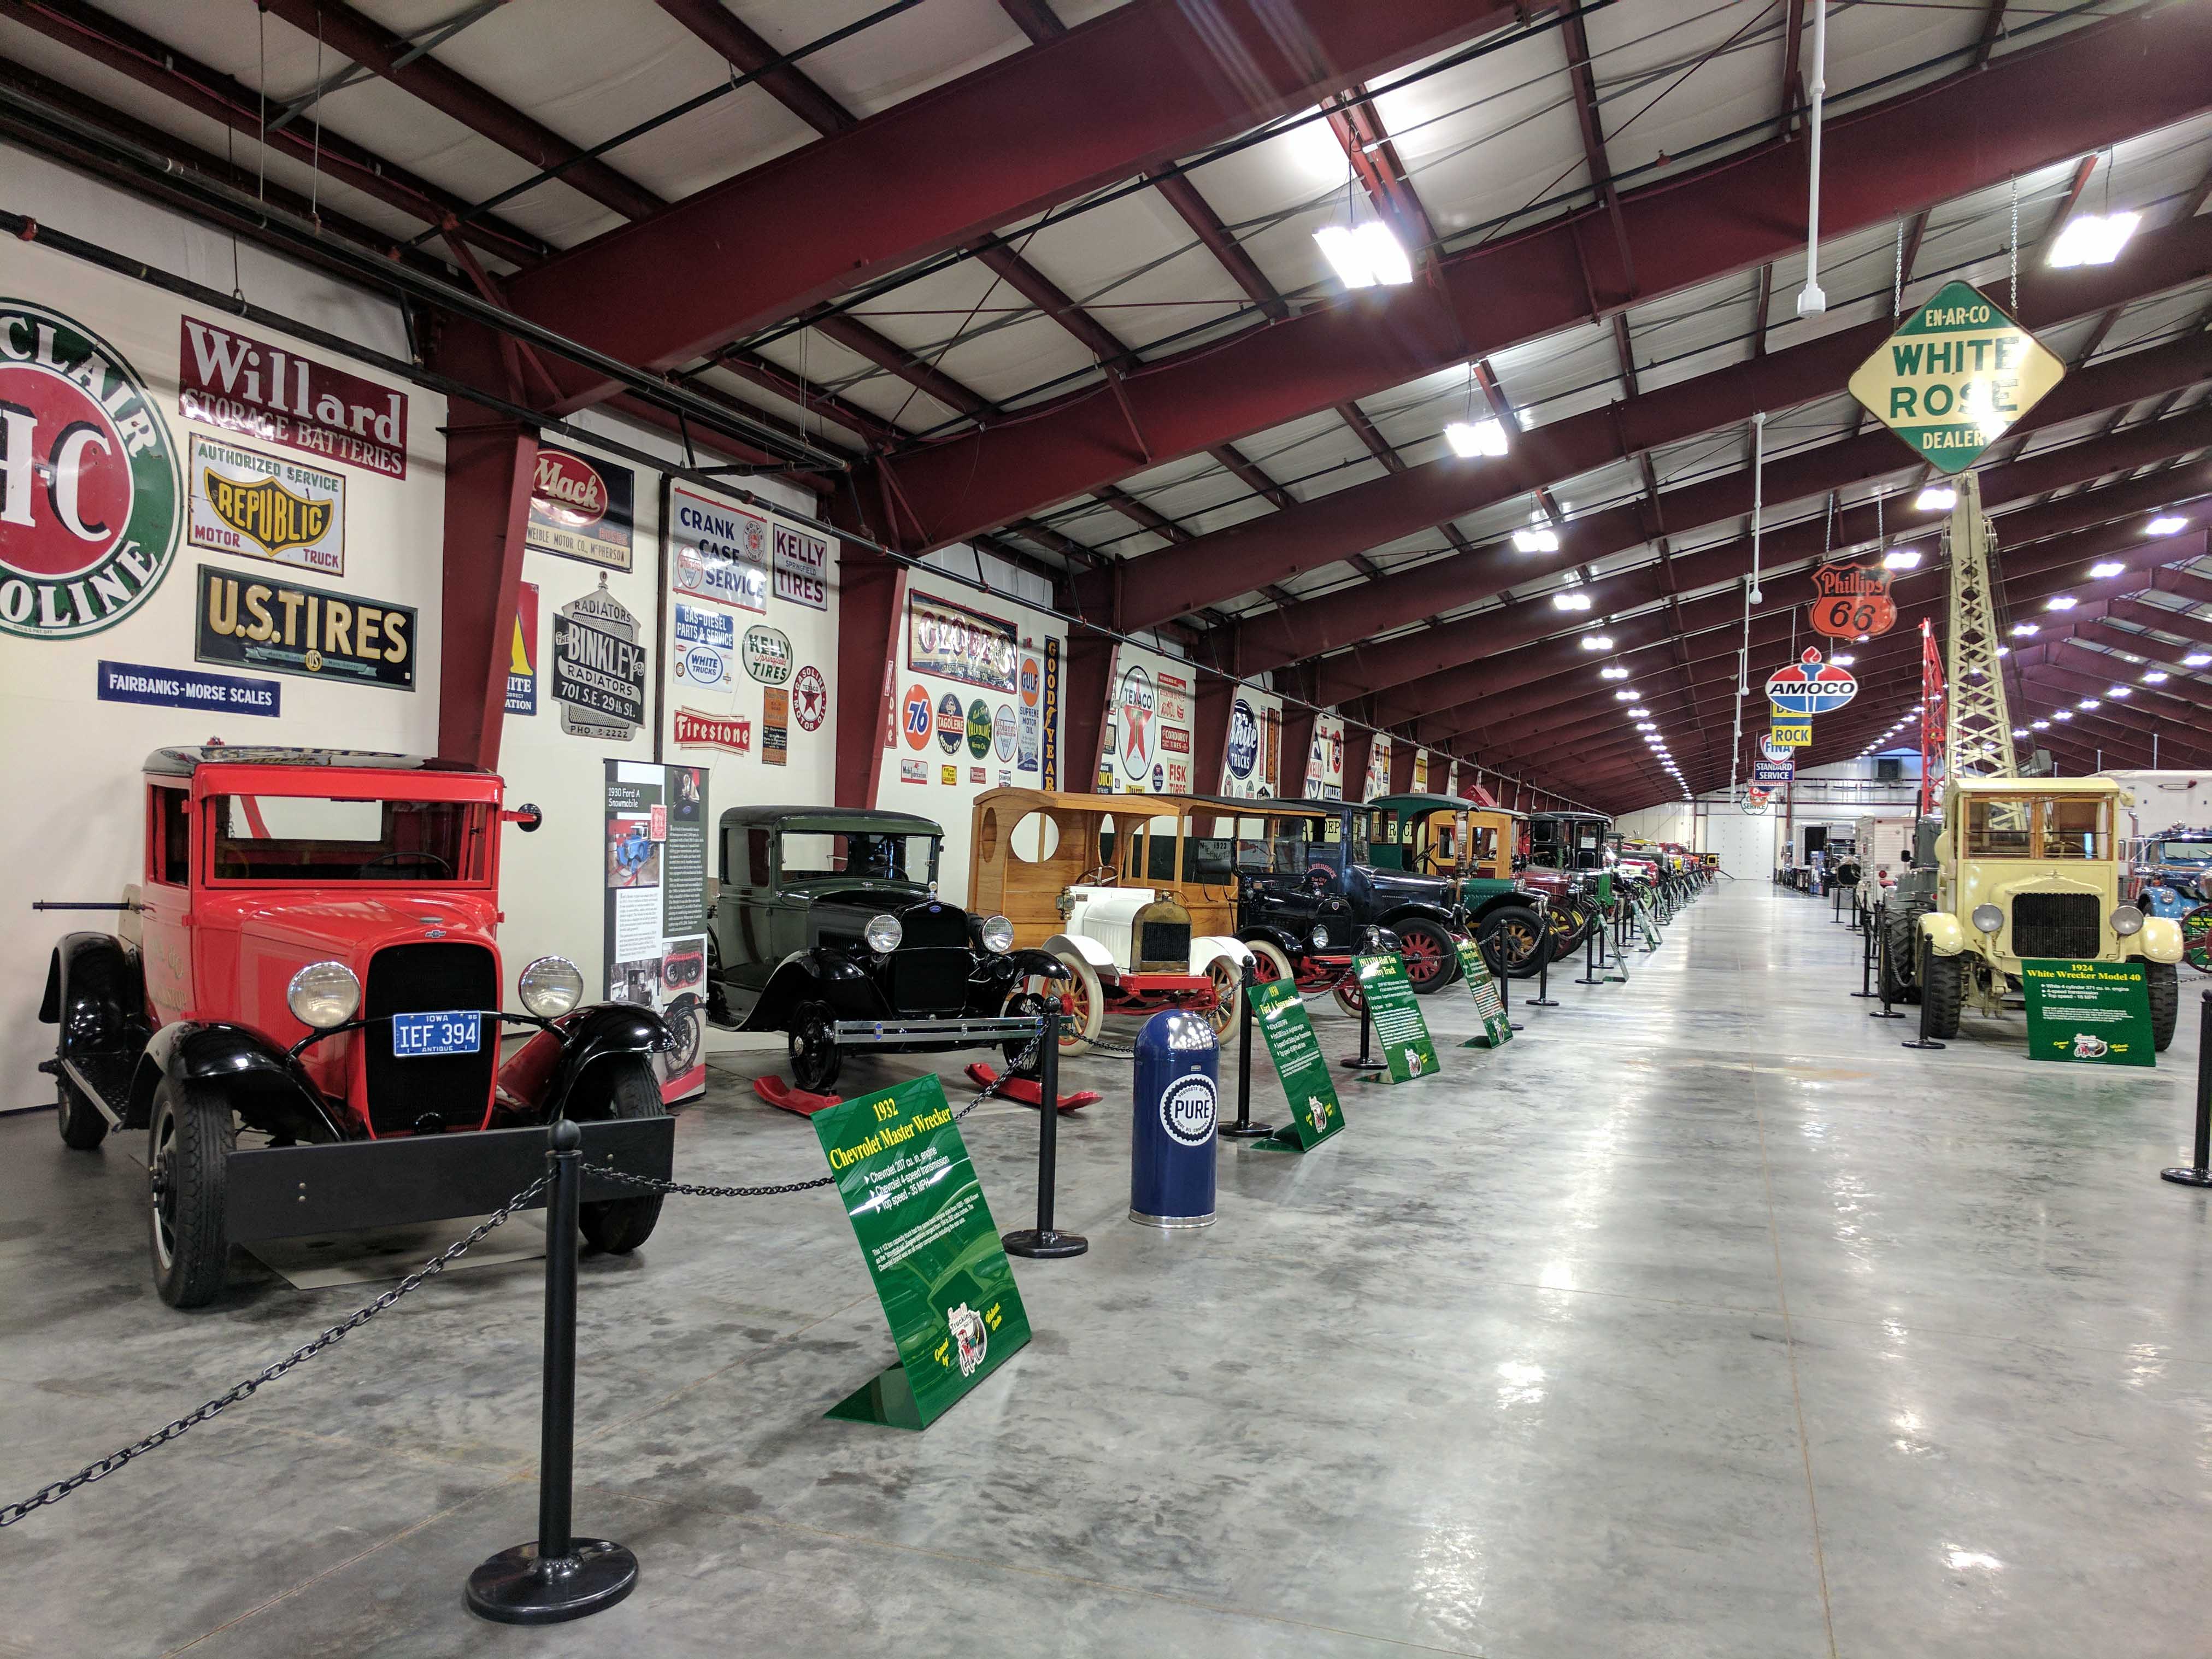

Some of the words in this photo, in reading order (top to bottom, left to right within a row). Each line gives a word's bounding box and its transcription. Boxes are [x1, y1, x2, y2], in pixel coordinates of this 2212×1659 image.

[1926, 306, 1990, 327] EN-AR-CO
[1893, 337, 2020, 376] WHITE
[0, 316, 157, 458] CLAIR
[184, 320, 403, 448] Willard
[185, 389, 289, 441] STORAGE
[297, 420, 403, 474] BATTERIES
[1923, 430, 1984, 449] DEALER
[198, 444, 281, 477] AUTHORIZED
[287, 467, 339, 492] SERVICE
[533, 457, 600, 509] Mack
[219, 483, 322, 543] REPUBLIC
[680, 507, 735, 540] CRANK
[195, 525, 241, 548] MOTOR
[303, 549, 339, 568] TRUCK
[554, 533, 574, 549] MOTOR
[599, 528, 628, 545] BUSES
[699, 539, 740, 567] CASE
[776, 531, 825, 567] KELLY
[786, 560, 816, 576] SPRINGFIELD
[0, 539, 159, 627] OLINE
[706, 568, 766, 598] SERVICE
[776, 569, 823, 603] TIRES
[1821, 571, 1884, 597] Phillips
[575, 601, 631, 622] RADIATORS
[684, 608, 727, 631] GAS-DIESEL
[1829, 601, 1876, 631] 66
[677, 622, 698, 639] PARTS
[699, 630, 705, 640] &
[707, 628, 733, 647] SERVICE
[568, 622, 640, 683] BINKLEY
[633, 663, 644, 671] CO.
[749, 634, 789, 660] KELLY
[691, 654, 718, 668] WHITE
[693, 665, 716, 676] TRUCKS
[753, 662, 787, 681] TIRES
[755, 654, 787, 667] Springfield
[109, 673, 226, 701] FAIRBANKS-MORSE
[230, 687, 273, 706] SCALES
[568, 664, 632, 696] RADIATORS
[795, 668, 825, 692] GASOLINE
[1022, 672, 1038, 692] GULF
[1769, 683, 1855, 695] AMOCO
[561, 681, 579, 700] 701
[582, 687, 601, 706] S.E.
[602, 695, 622, 714] 29th
[624, 704, 636, 717] St.
[1125, 687, 1152, 710] TEXACO
[794, 700, 814, 731] MOTOR
[817, 704, 826, 723] OIL
[907, 699, 929, 736] 76
[938, 716, 963, 731] TAGOLENE
[1020, 707, 1039, 718] SUPREME
[1022, 716, 1037, 726] MOTOR
[570, 726, 593, 735] PHO.
[676, 716, 749, 744] Firestone
[968, 719, 992, 740] VALVOLINE
[1165, 730, 1189, 743] CORDUROY
[1776, 730, 1809, 742] ROCK
[940, 734, 953, 752] MOTOR
[1170, 740, 1181, 749] TIRES
[1766, 742, 1791, 752] FINA
[1231, 753, 1250, 770] TRUCKS
[1756, 763, 1792, 771] STANDARD
[1098, 771, 1113, 787] OUCH
[1169, 764, 1186, 783] FISK
[608, 798, 638, 808] Snowmobile
[609, 787, 621, 797] 1930
[622, 787, 635, 797] Ford
[636, 790, 640, 798] A
[2056, 970, 2096, 980] Wrecker
[399, 1025, 434, 1048] IEF
[442, 1022, 476, 1045] 394
[1178, 1086, 1198, 1098] PRODUCTS
[873, 1098, 899, 1122] 1932
[1175, 1099, 1210, 1119] PURE
[829, 1137, 883, 1170] Chevrolet
[879, 1124, 915, 1149] Master
[912, 1108, 951, 1133] Wrecker
[870, 1163, 897, 1184] Chevrolet
[895, 1158, 907, 1173] 207
[905, 1159, 915, 1167] cu.
[913, 1154, 921, 1163] in.
[920, 1146, 938, 1160] engine
[875, 1177, 902, 1197] Chevrolet
[901, 1168, 922, 1185] 4-speed
[919, 1155, 950, 1174] transmission
[881, 1199, 892, 1210] Top
[891, 1189, 909, 1206] speed
[909, 1184, 919, 1196] 35
[916, 1178, 931, 1192] MPH
[951, 1312, 972, 1330] Trucking
